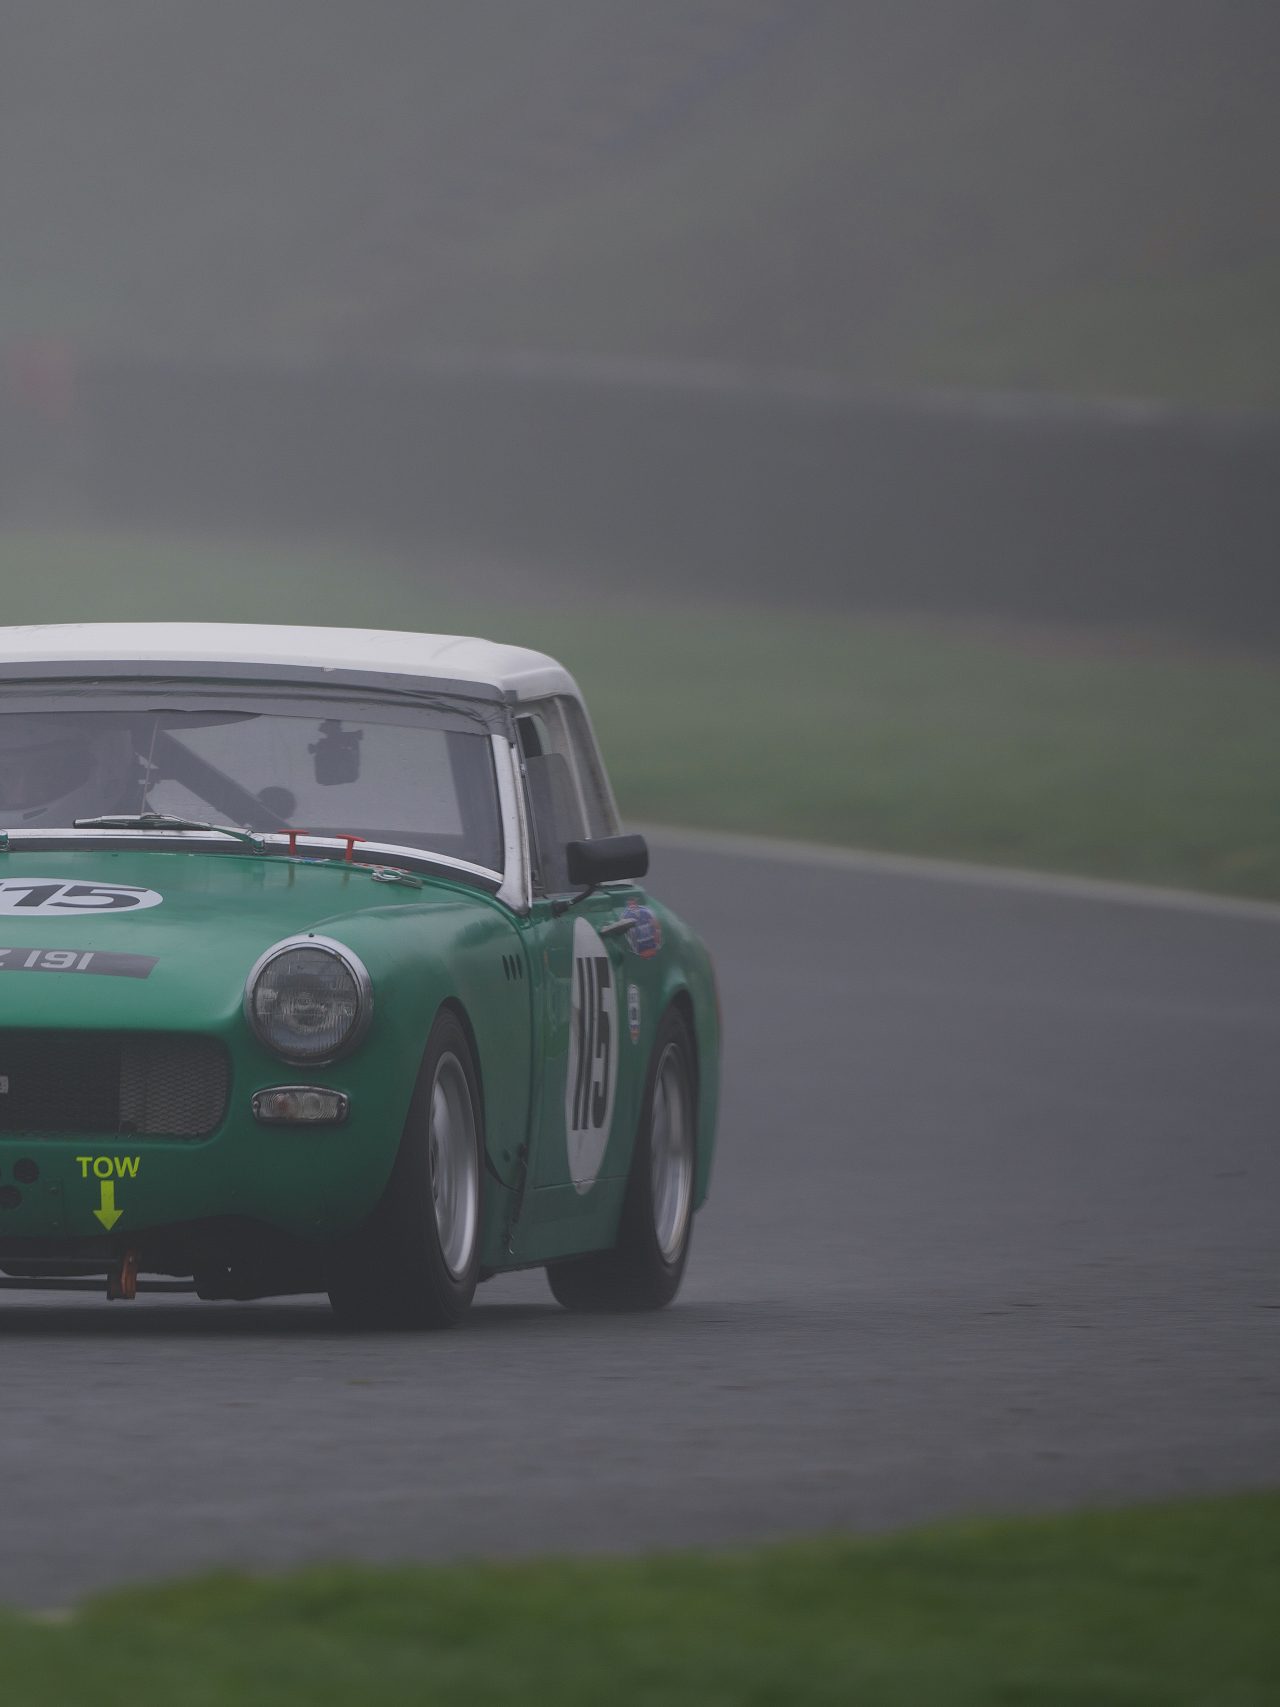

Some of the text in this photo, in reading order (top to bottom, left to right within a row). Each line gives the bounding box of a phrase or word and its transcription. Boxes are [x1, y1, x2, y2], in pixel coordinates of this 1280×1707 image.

[23, 950, 95, 970] 191
[572, 956, 611, 1131] 115
[76, 1156, 141, 1178] TOW
